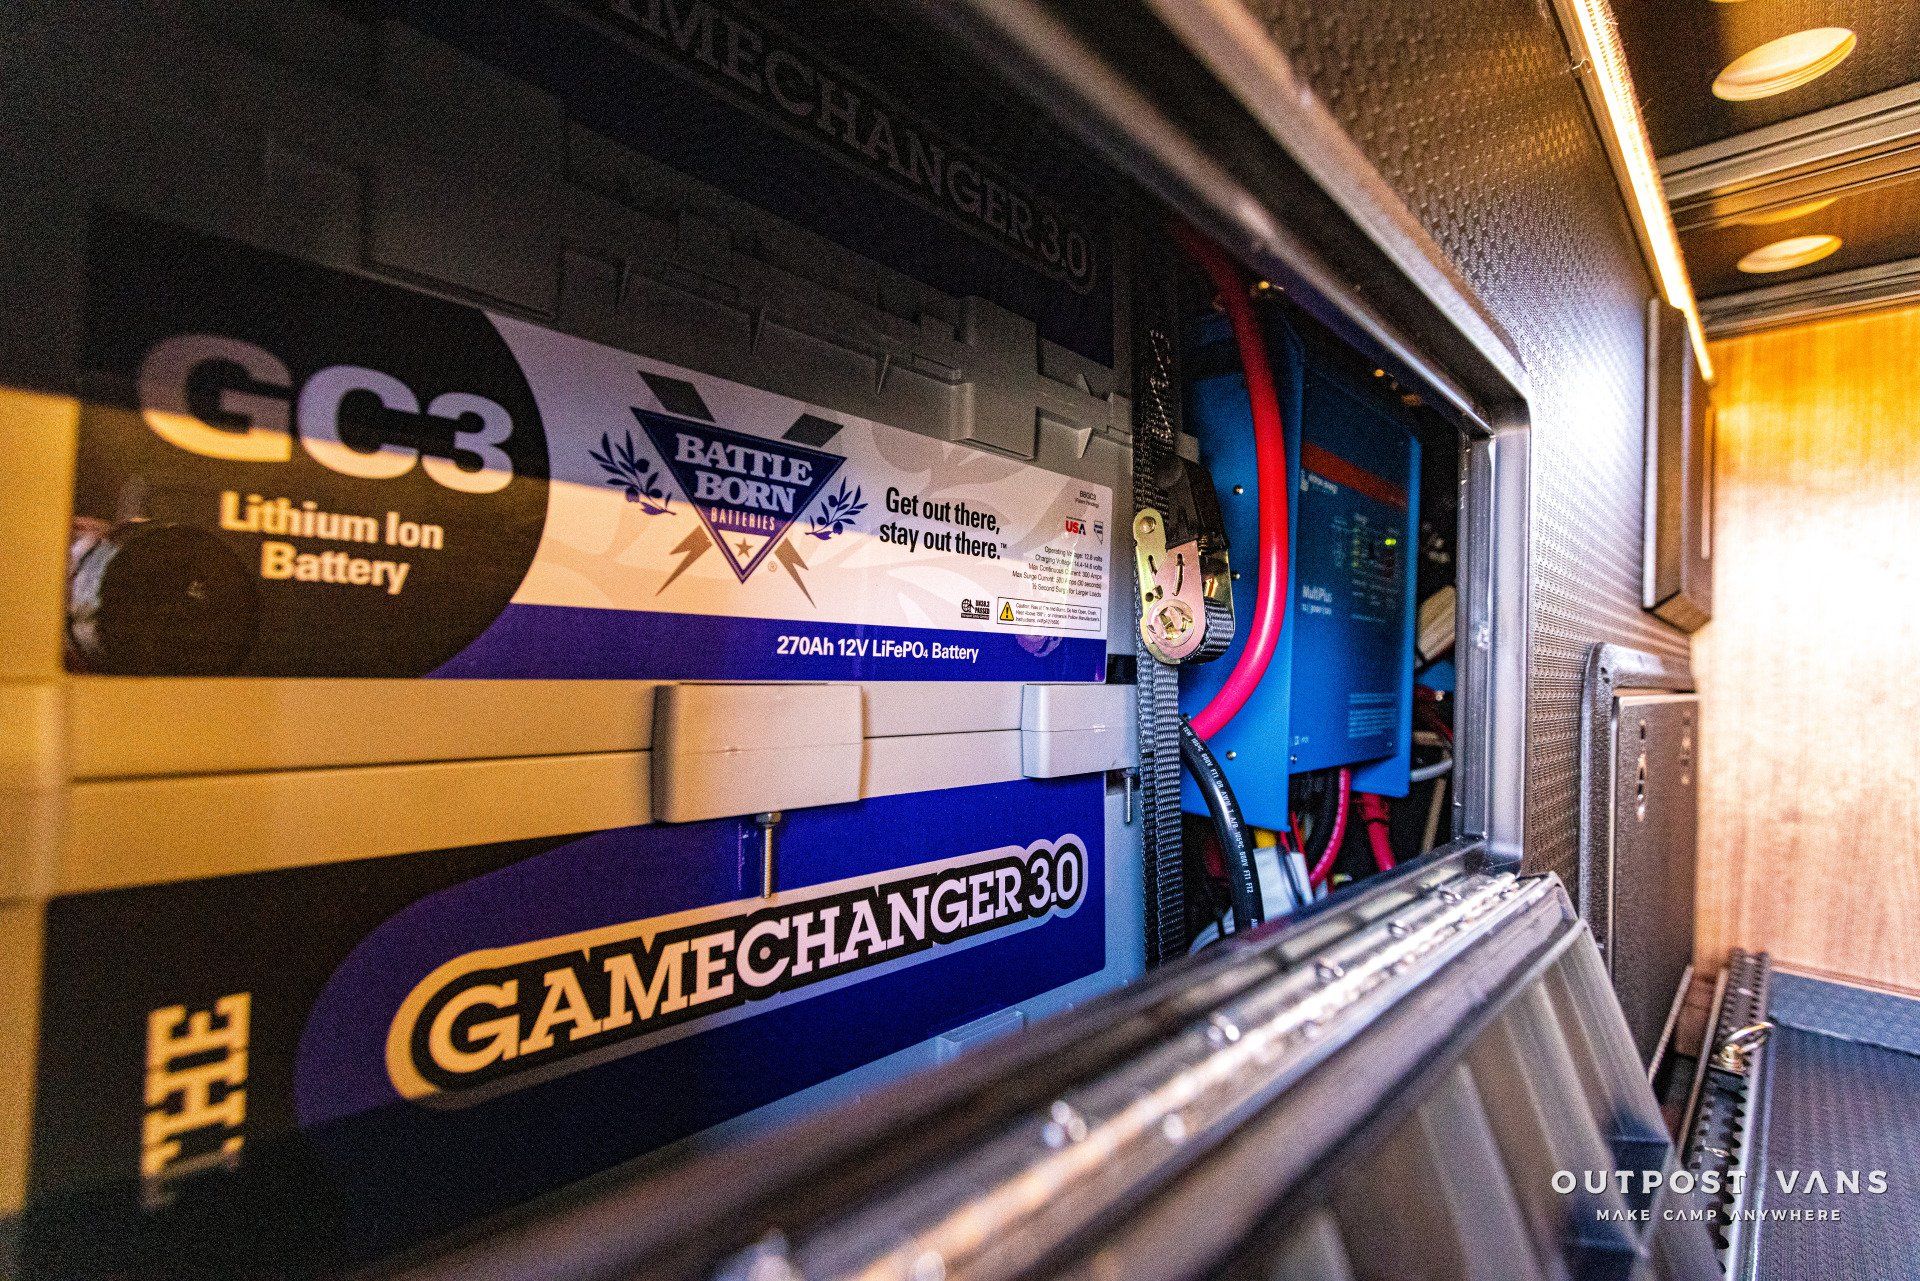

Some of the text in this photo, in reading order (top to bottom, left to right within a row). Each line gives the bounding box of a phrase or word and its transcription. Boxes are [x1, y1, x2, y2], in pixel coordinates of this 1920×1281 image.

[1040, 213, 1089, 278] 3.0
[137, 333, 514, 494] GC3
[675, 432, 813, 486] BATTLE
[693, 470, 796, 514] BORN
[710, 507, 776, 531] BATTERIES
[886, 487, 1000, 534] Get out there,
[220, 491, 444, 550] Lithium Ion
[880, 522, 919, 553] stay
[923, 531, 951, 552] out
[1065, 520, 1086, 535] USA
[261, 540, 411, 595] Battery
[777, 635, 834, 656] 270Ah
[837, 638, 869, 657] 12V
[931, 642, 979, 663] Battery
[428, 849, 1079, 1075] GAMECHANGER 3.0
[141, 992, 251, 1209] THE
